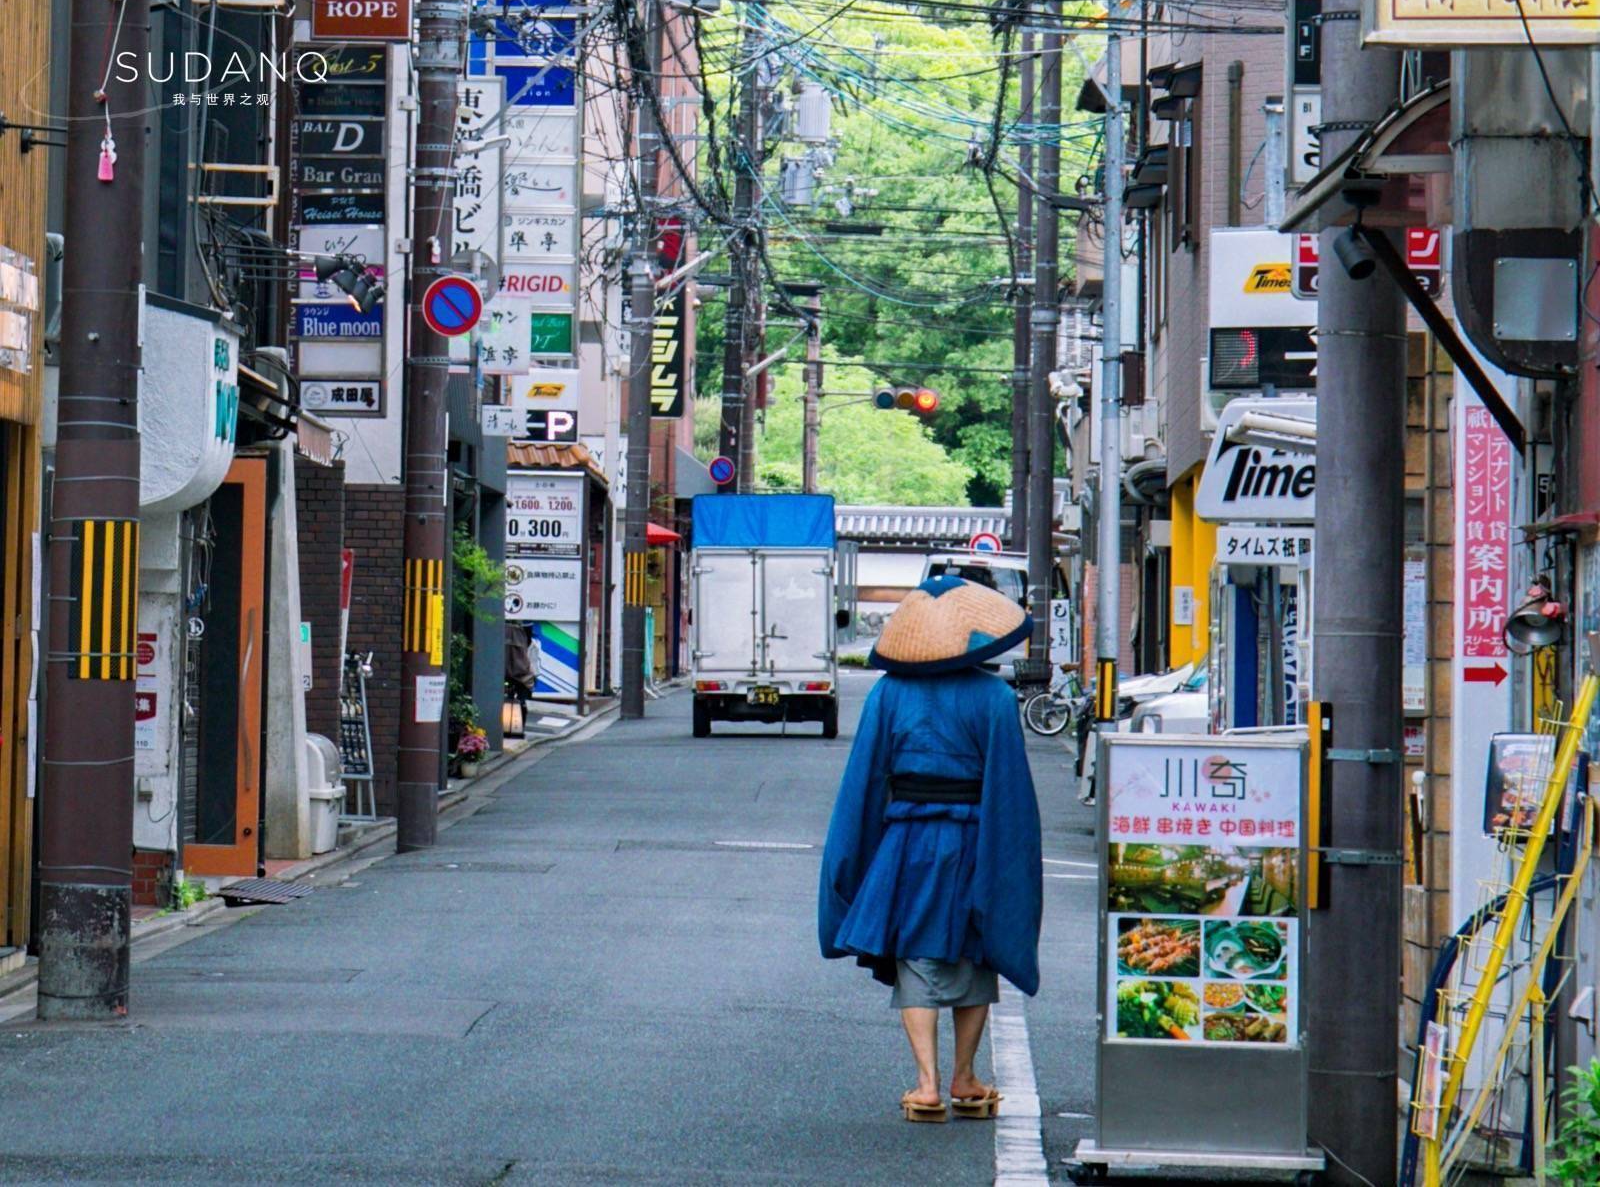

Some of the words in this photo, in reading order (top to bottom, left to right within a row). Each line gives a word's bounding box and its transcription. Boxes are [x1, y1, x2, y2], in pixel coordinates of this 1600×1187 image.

[326, 0, 398, 19] ROPE
[302, 122, 335, 133] BAL
[331, 122, 365, 152] D
[304, 166, 335, 183] Bar
[341, 167, 383, 184] Gran
[302, 317, 337, 337] Blue
[340, 320, 381, 337] moon
[546, 411, 574, 441] P
[1215, 443, 1316, 503] Time
[1466, 433, 1486, 515] マンション
[1490, 436, 1509, 513] テナント
[527, 519, 562, 538] 300
[1466, 543, 1507, 635] 案内所
[1172, 803, 1237, 813] KAWAKI
[1112, 816, 1151, 835] 海鮮
[1156, 817, 1212, 836] 串焼き
[1218, 818, 1296, 839] 中国料理
